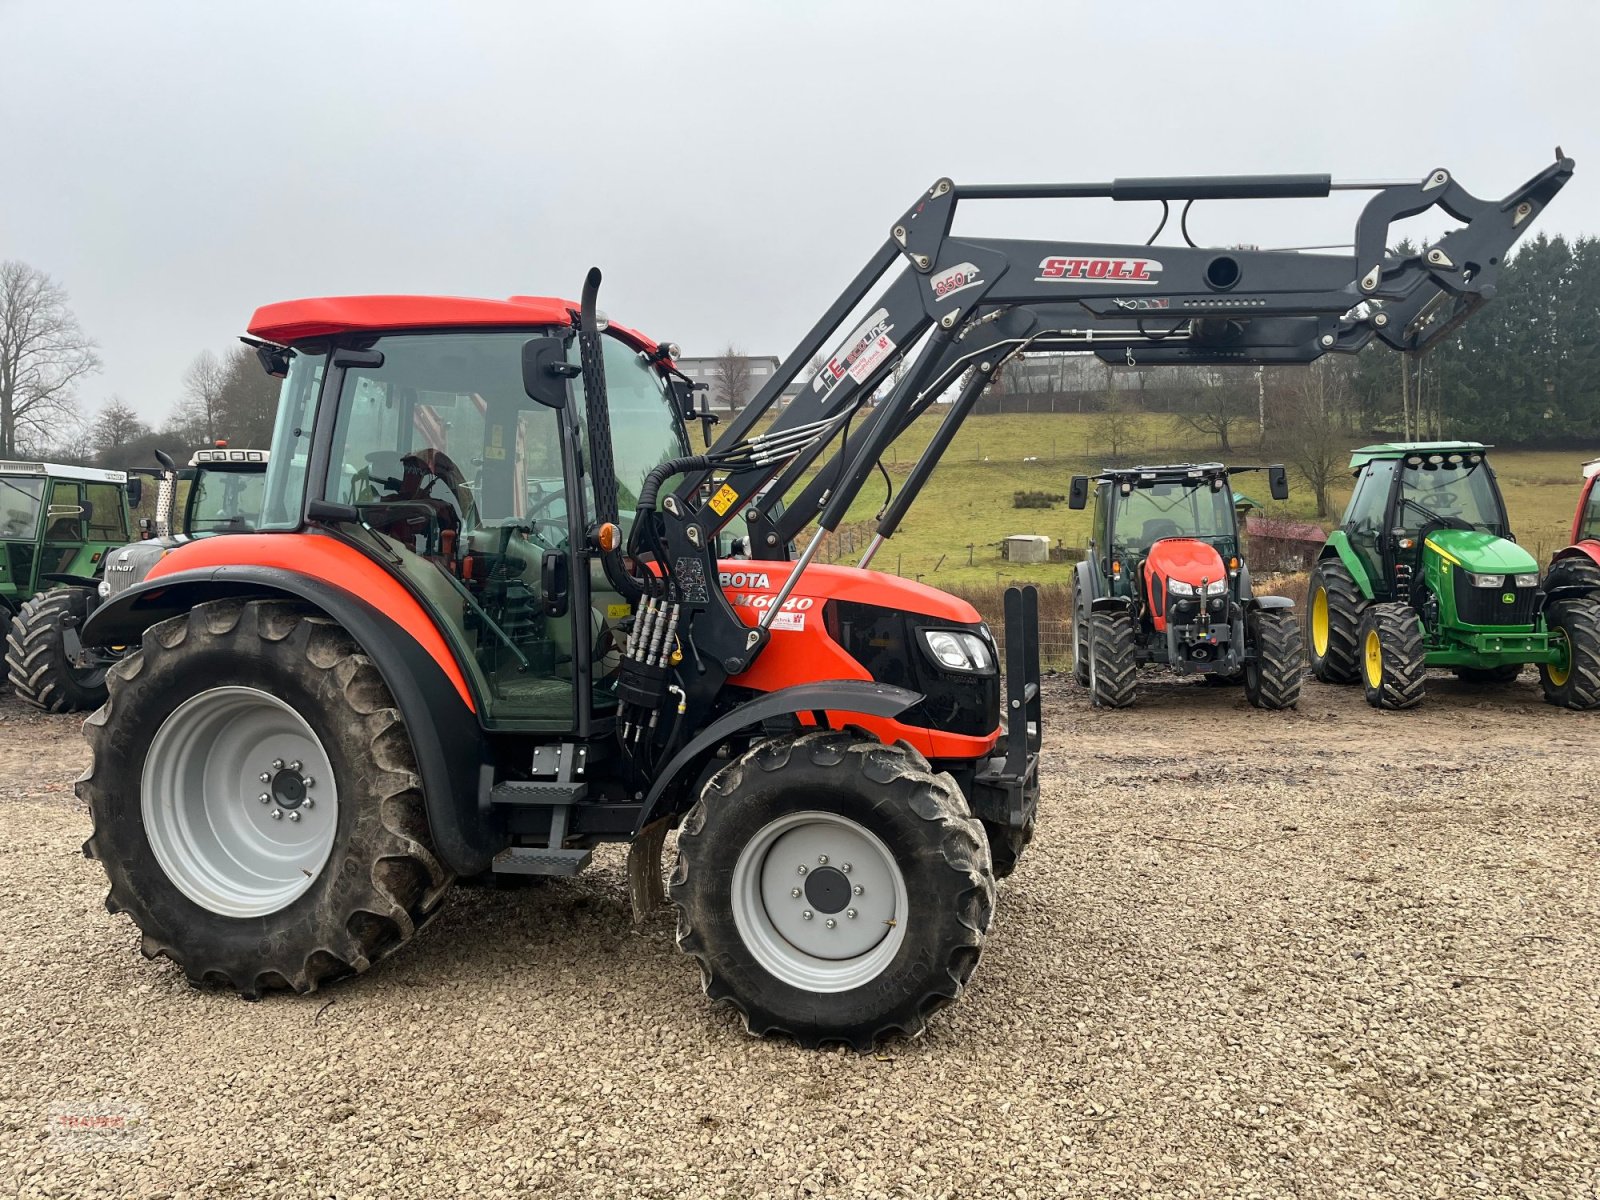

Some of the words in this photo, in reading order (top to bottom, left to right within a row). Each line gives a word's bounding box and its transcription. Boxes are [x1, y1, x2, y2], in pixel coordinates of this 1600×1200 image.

[1041, 259, 1151, 280] STOLL
[936, 272, 965, 297] 850
[819, 356, 846, 391] FE
